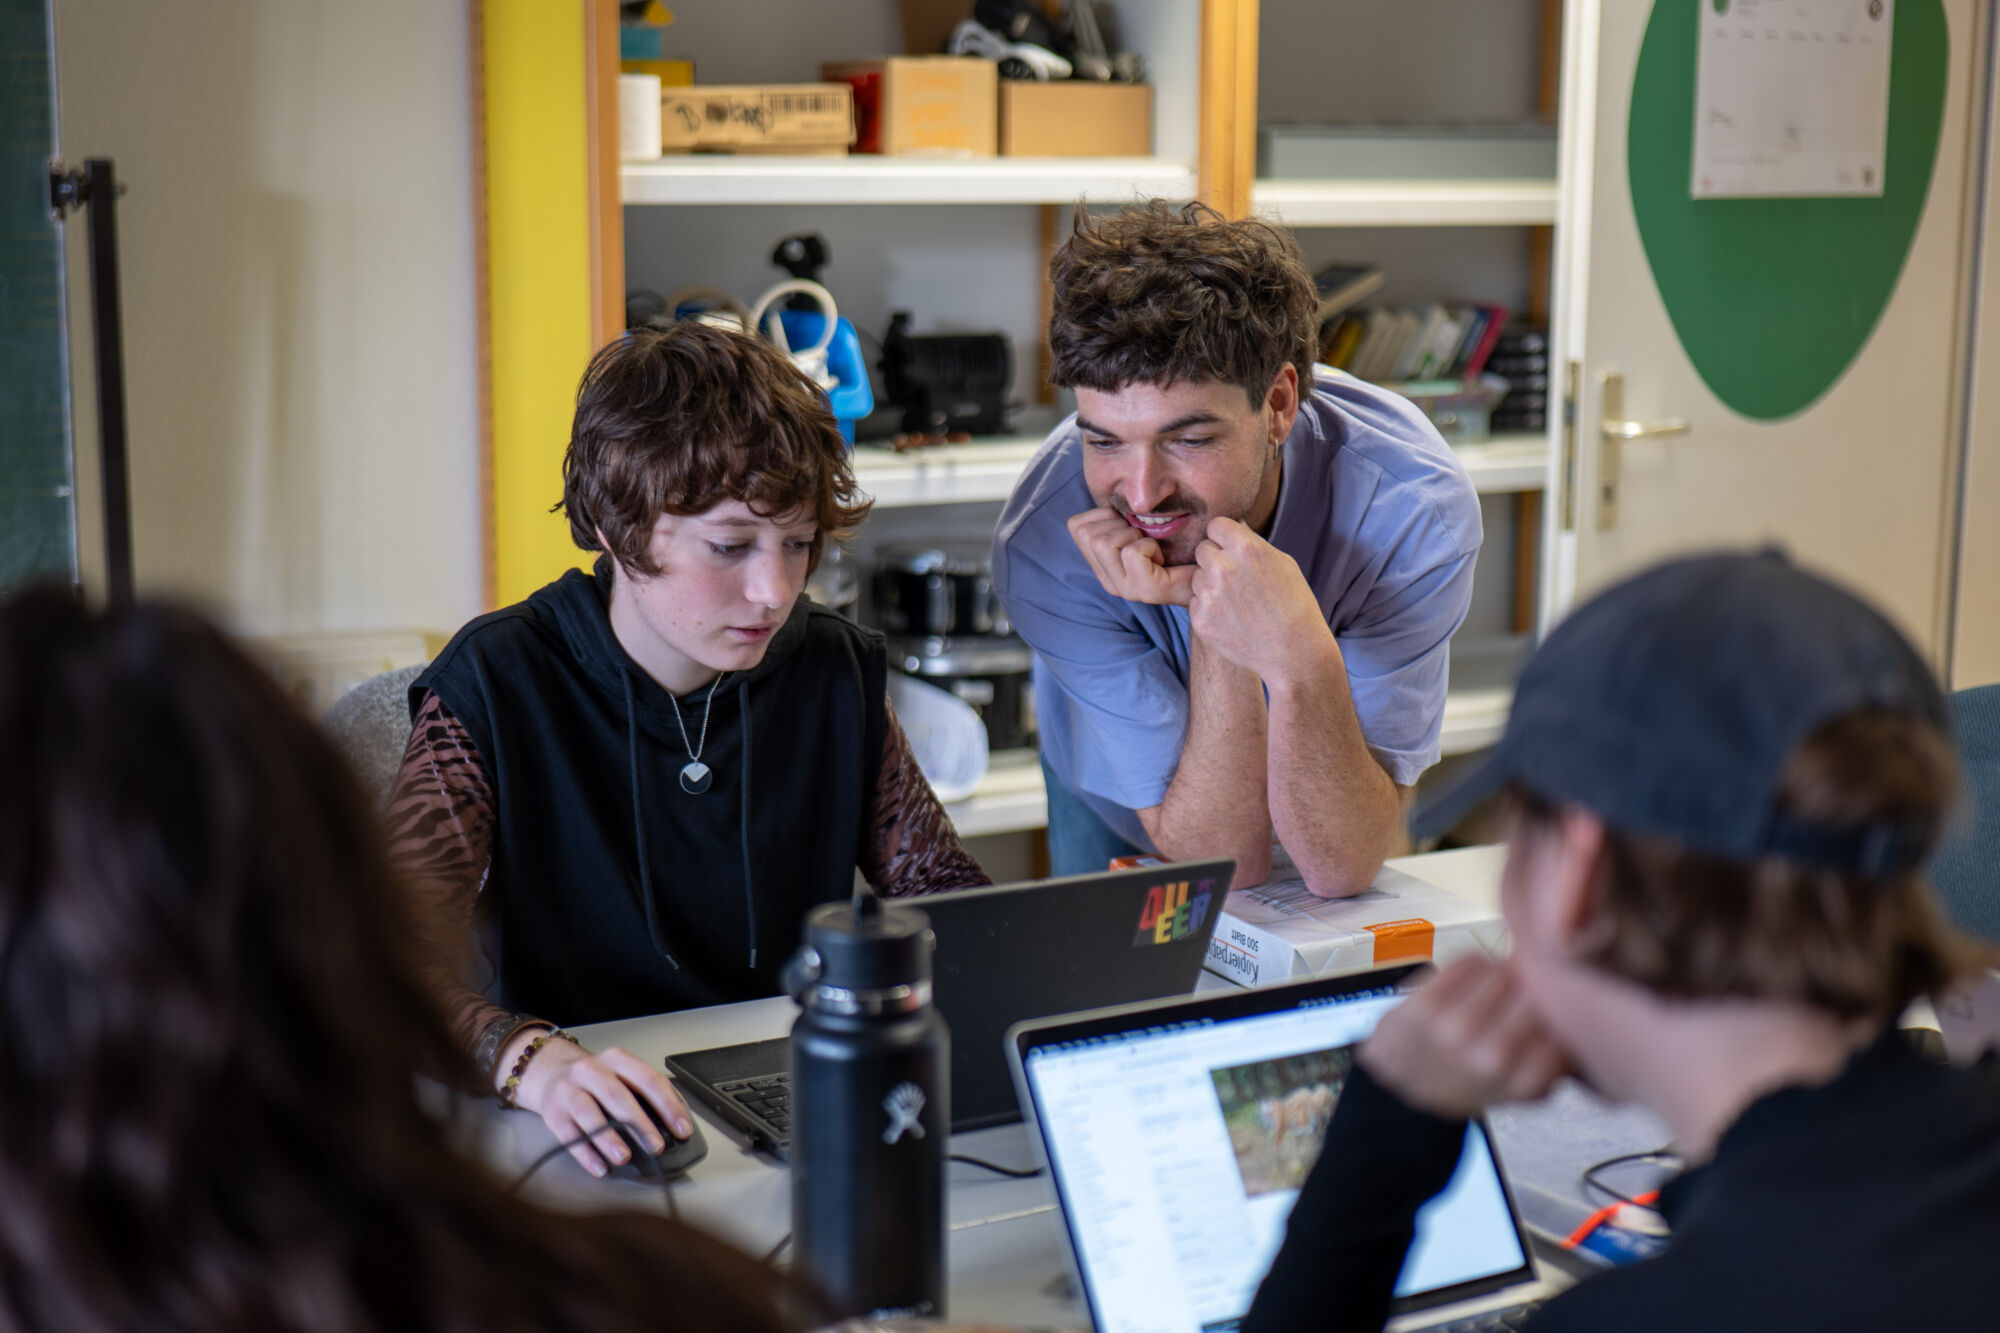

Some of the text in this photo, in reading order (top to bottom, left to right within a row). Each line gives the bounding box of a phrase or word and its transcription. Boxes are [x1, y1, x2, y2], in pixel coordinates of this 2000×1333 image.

[1231, 929, 1259, 952] 500 Blatt
[1208, 937, 1259, 986] Kopierpapi
